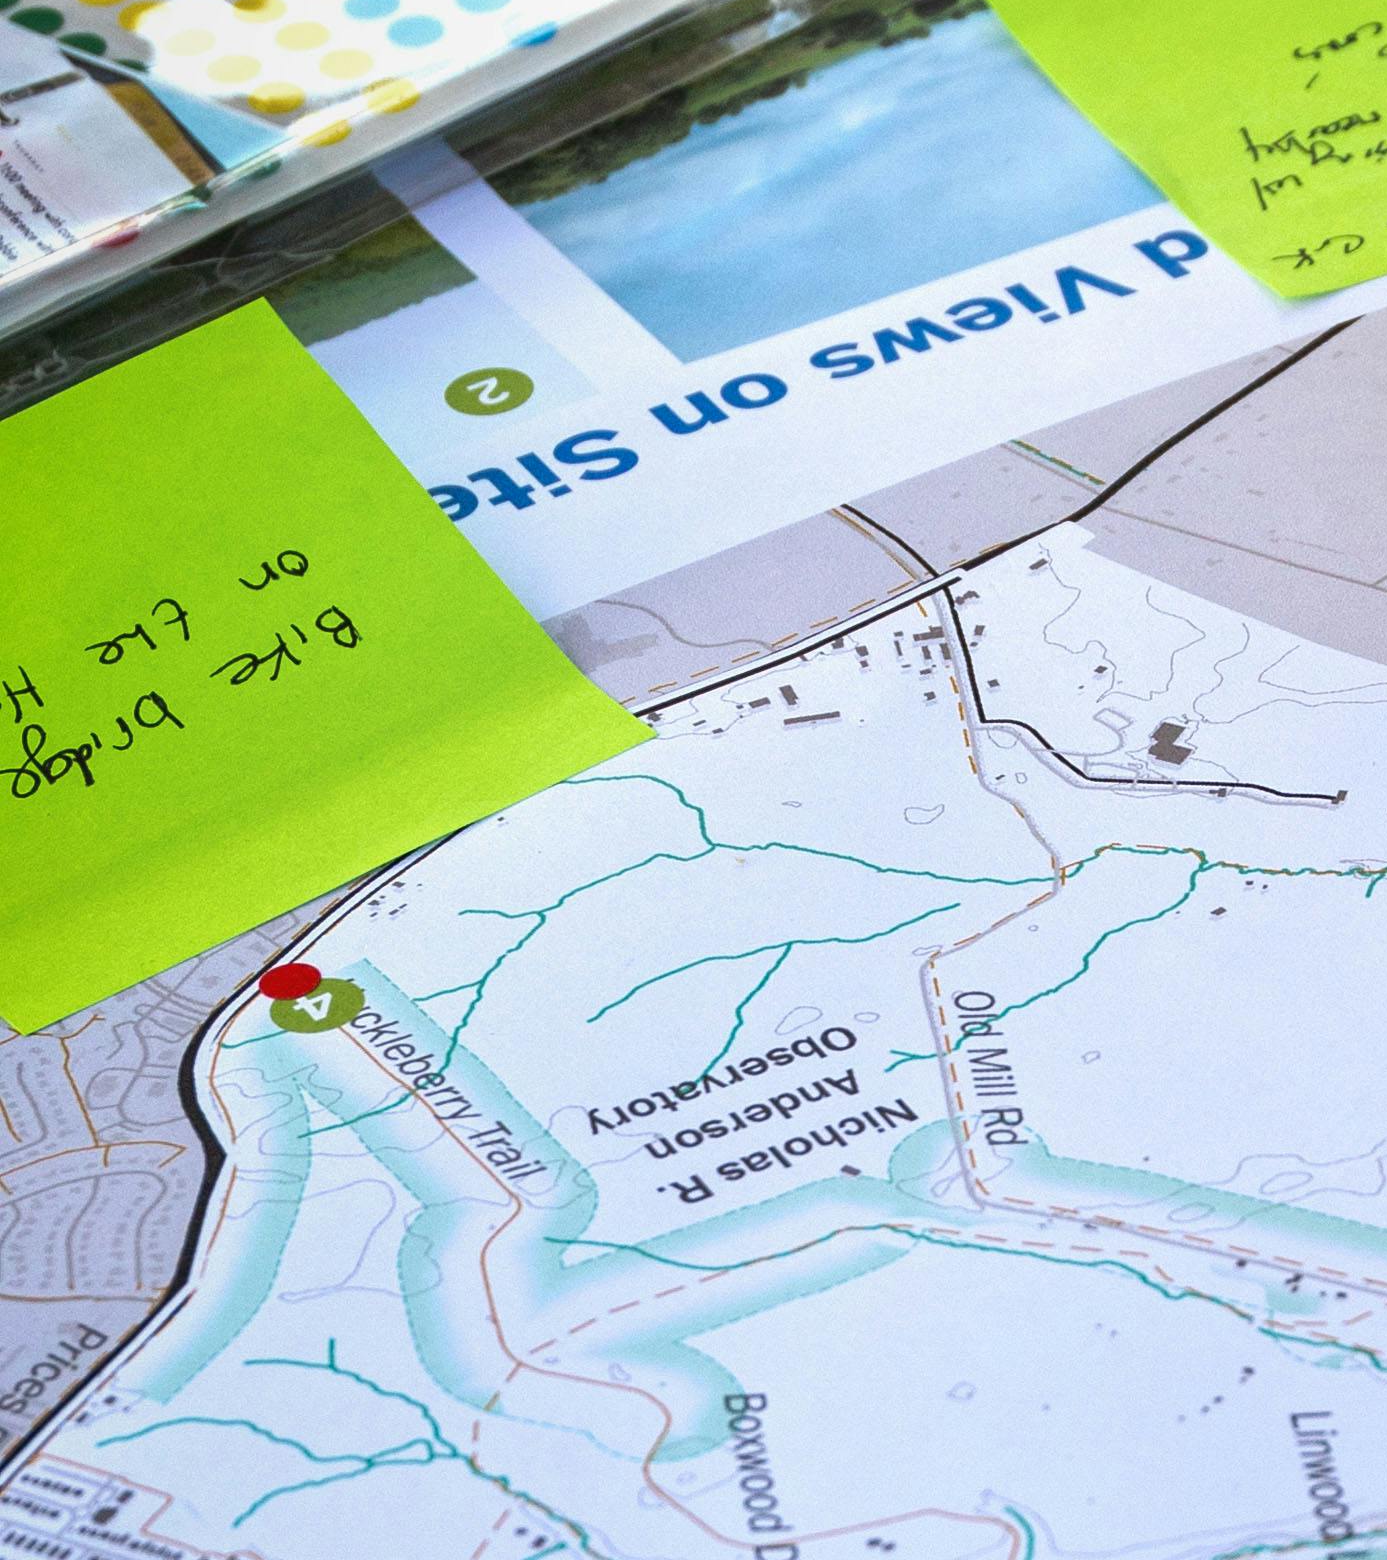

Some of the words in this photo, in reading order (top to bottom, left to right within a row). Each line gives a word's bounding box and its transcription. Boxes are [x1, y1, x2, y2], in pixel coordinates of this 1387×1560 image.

[809, 260, 1138, 382] Views
[466, 377, 512, 408] 2
[648, 371, 789, 442] on
[420, 428, 641, 524] Site
[84, 598, 188, 665] the
[0, 691, 184, 799] bridge
[953, 990, 999, 1037] Old
[349, 1006, 483, 1121] ckleberry
[468, 1121, 548, 1180] Trail
[585, 1024, 858, 1137] Observatory
[643, 1069, 862, 1162] Anderson
[964, 1046, 1019, 1100] Mill
[716, 1098, 919, 1188] Nicholas
[981, 1105, 1028, 1148] Rd
[656, 1173, 714, 1207] R.
[0, 1322, 107, 1417] Prices
[722, 1392, 793, 1538] Boxwood
